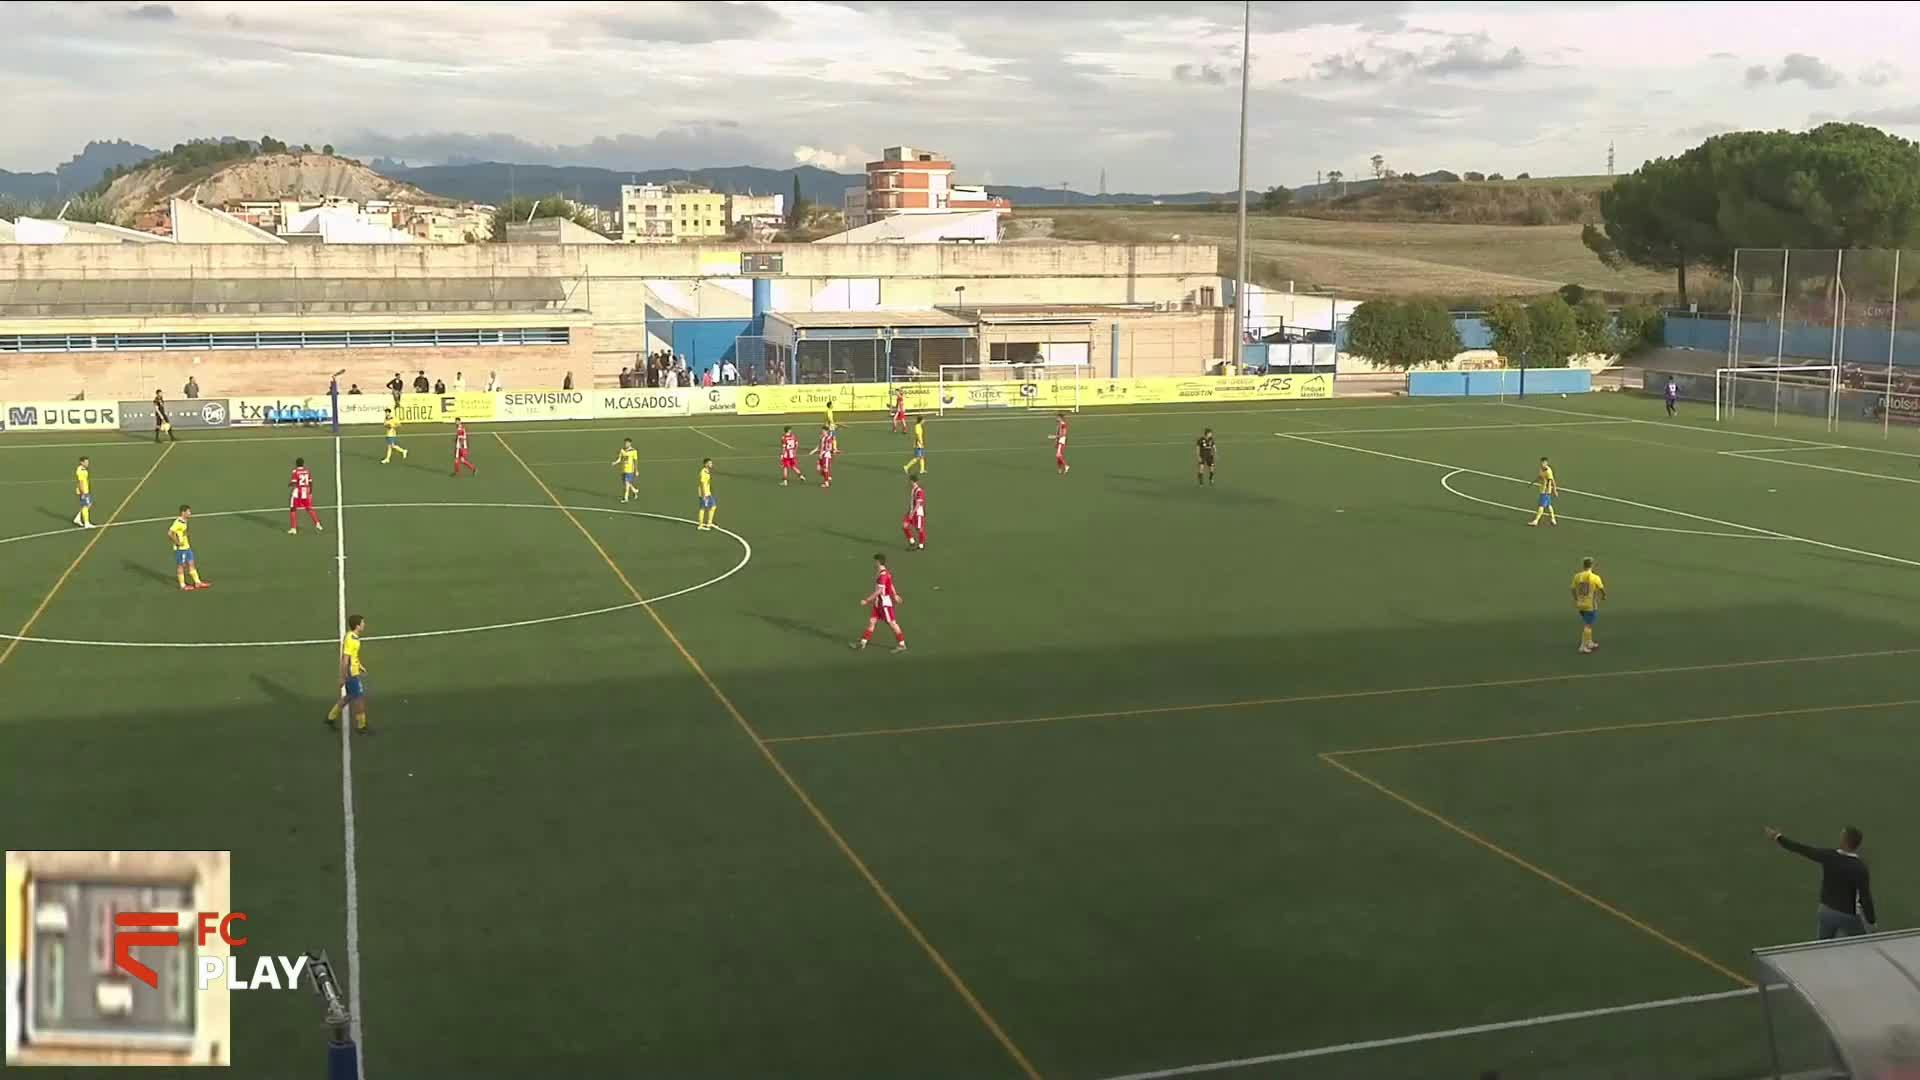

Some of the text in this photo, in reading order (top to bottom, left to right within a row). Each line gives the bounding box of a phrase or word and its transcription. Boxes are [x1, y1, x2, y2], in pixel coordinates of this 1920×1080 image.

[1257, 378, 1293, 392] ARS
[504, 392, 583, 405] SERVISIMO
[45, 408, 114, 424] DICOR
[298, 474, 309, 486] 21
